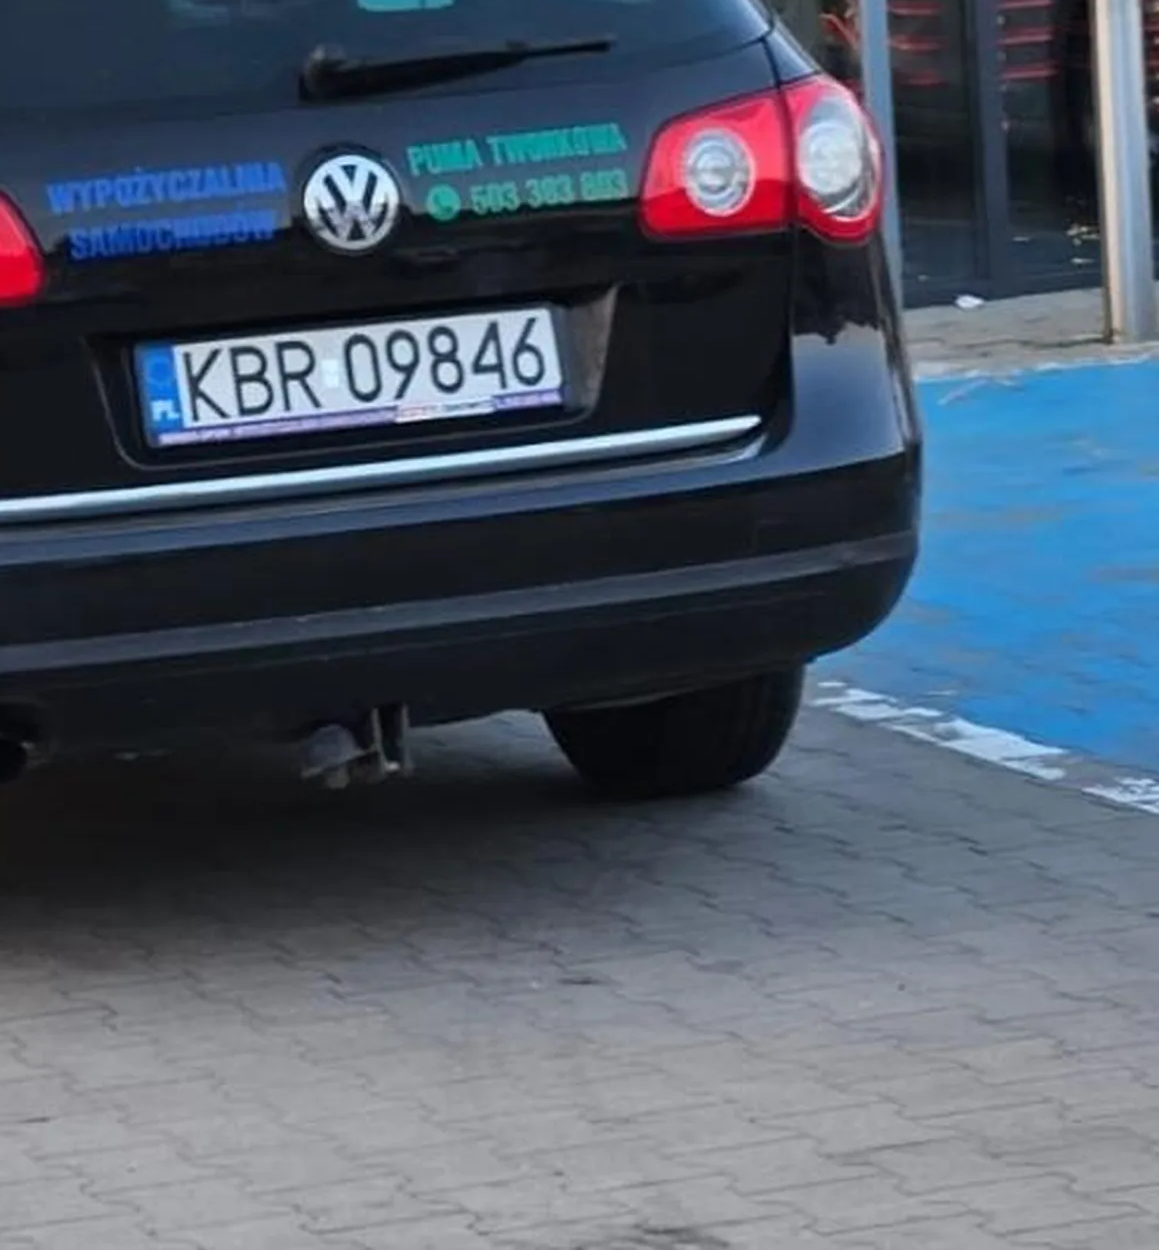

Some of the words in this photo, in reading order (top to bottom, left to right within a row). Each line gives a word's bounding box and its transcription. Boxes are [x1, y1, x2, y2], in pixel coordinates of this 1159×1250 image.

[46, 161, 288, 215] WYPOŻYCZALNIA
[182, 340, 321, 423] KBR
[343, 317, 547, 403] 09846
[151, 400, 180, 422] PL
